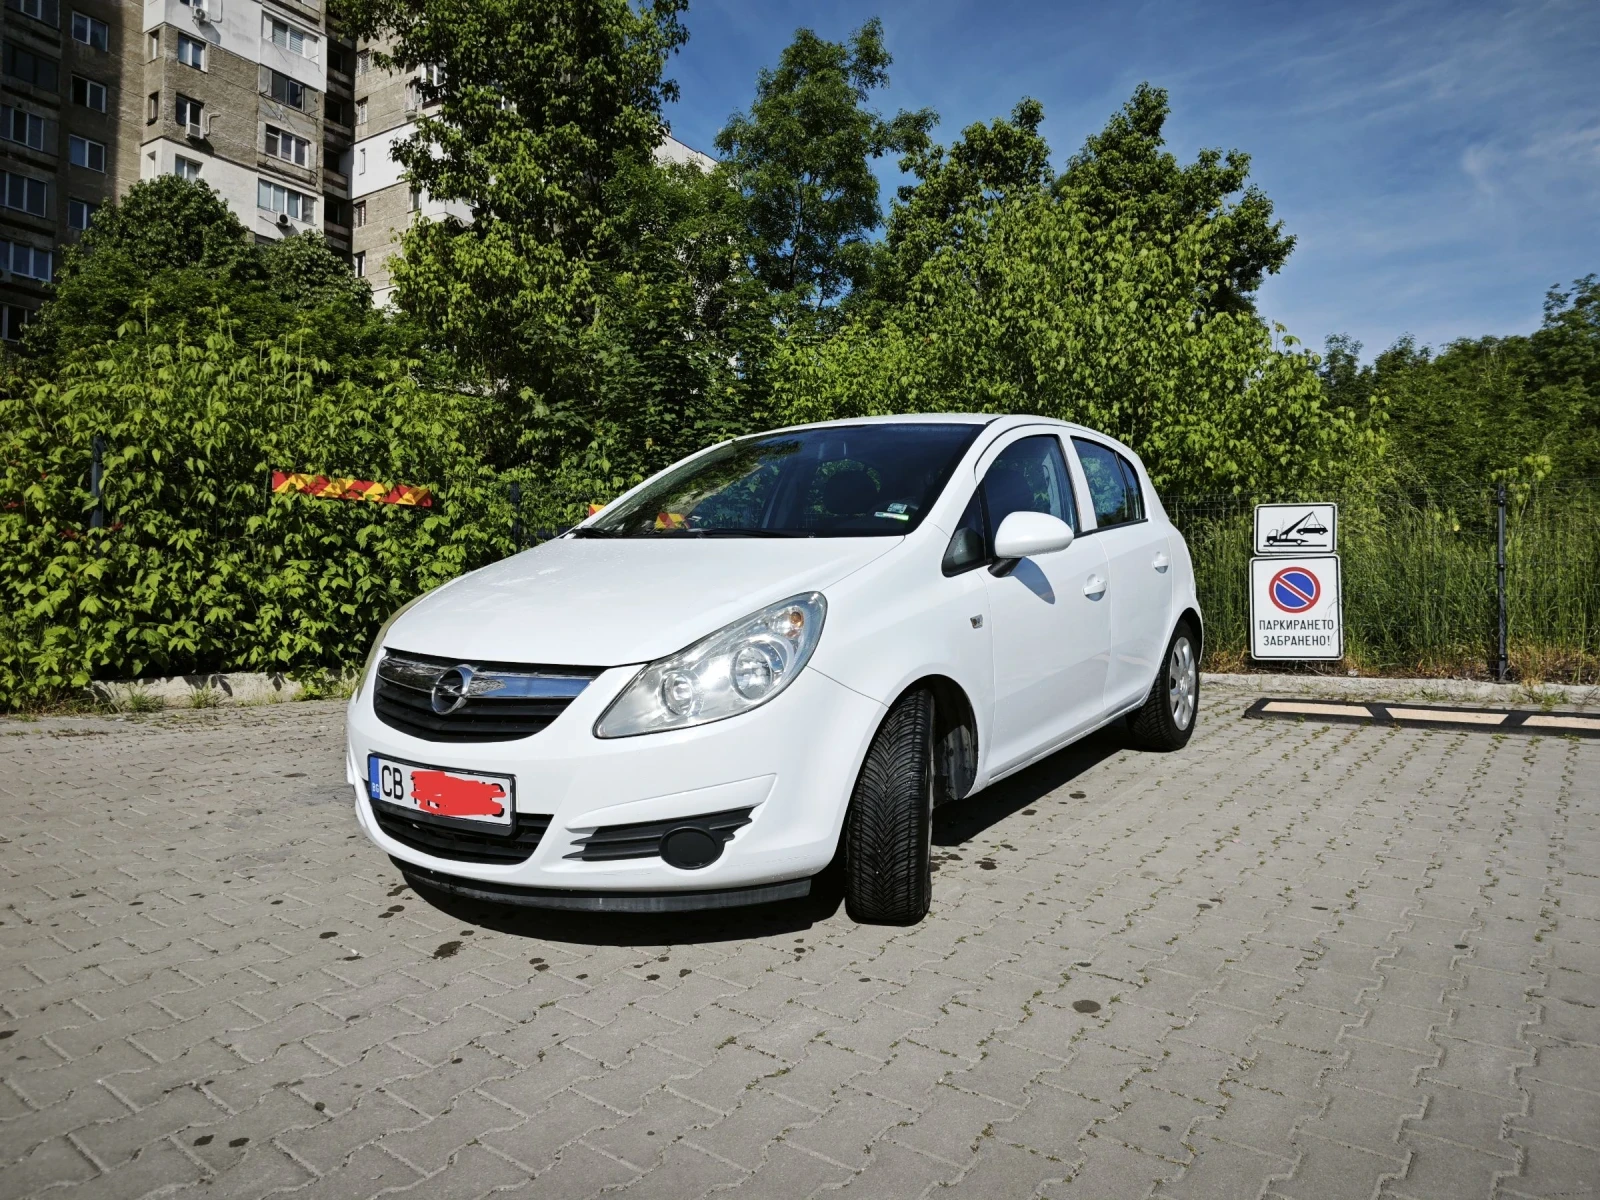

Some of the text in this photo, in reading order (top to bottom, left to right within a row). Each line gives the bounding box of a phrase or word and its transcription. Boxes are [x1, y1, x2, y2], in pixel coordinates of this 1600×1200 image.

[1259, 619, 1334, 630] ПАРКИРАНЕТО
[1263, 635, 1330, 646] ЗАБРАНЕНО!
[381, 765, 404, 800] CB
